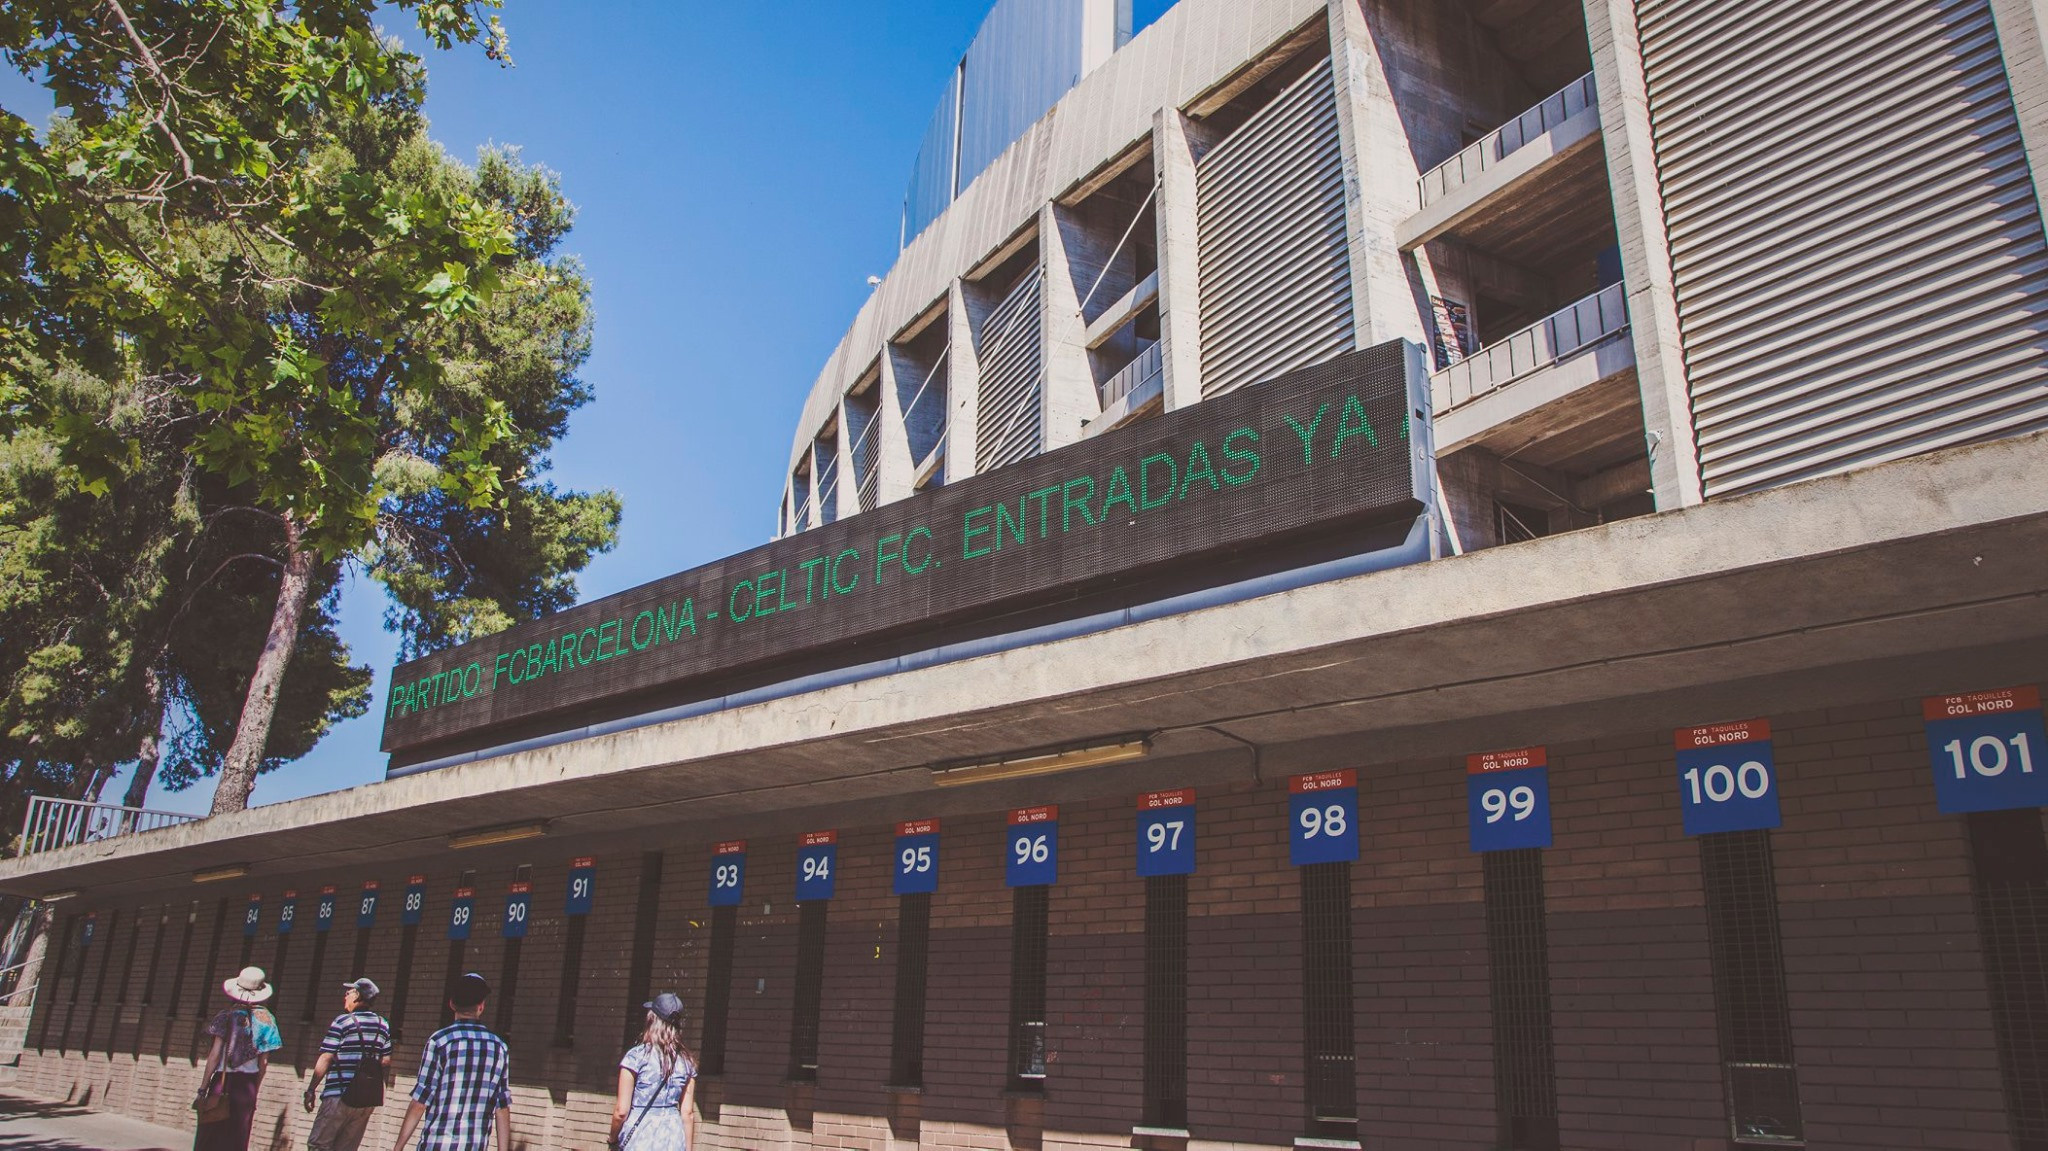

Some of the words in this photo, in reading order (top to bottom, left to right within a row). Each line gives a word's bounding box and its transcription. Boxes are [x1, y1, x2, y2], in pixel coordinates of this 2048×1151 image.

[390, 661, 486, 719] PARTIDO:
[492, 597, 697, 691] FCBARCELONA
[729, 547, 860, 623] CELTIC
[875, 526, 942, 585] FC.
[963, 428, 1260, 560] ENTRADAS
[1283, 395, 1378, 465] YA
[1946, 697, 1962, 705] FCB
[1967, 690, 2013, 702] TAQUILLES
[1947, 704, 1973, 715] GOL
[1977, 699, 2014, 712] NORD
[1693, 728, 1707, 736] FCB
[1710, 723, 1749, 734] TAQUILLES
[1694, 734, 1716, 746] GOL
[1719, 730, 1749, 743] NORD
[1482, 754, 1494, 762] FCB
[1496, 750, 1529, 760] TAQUILLES
[1482, 761, 1500, 770] GOL
[1503, 756, 1529, 768] NORD
[1944, 732, 2033, 779] 101
[1302, 781, 1318, 790] GOL
[1320, 778, 1342, 788] NORD
[1684, 761, 1769, 804] 100
[1149, 799, 1162, 807] GOL
[1163, 796, 1183, 806] NORD
[1481, 785, 1535, 824] 99
[1030, 813, 1047, 821] NORD
[1300, 804, 1347, 840] 98
[904, 826, 915, 834] GOL
[916, 825, 931, 833] NORD
[1147, 820, 1184, 853] 97
[1015, 834, 1049, 865] 96
[803, 856, 829, 882] 94
[901, 846, 931, 874] 95
[716, 864, 738, 888] 93
[573, 878, 589, 899] 91
[319, 902, 332, 918] 86
[361, 897, 375, 915] 87
[406, 892, 421, 911] 88
[247, 908, 259, 924] 84
[281, 905, 294, 921] 85
[453, 906, 470, 926] 89
[508, 902, 526, 923] 90
